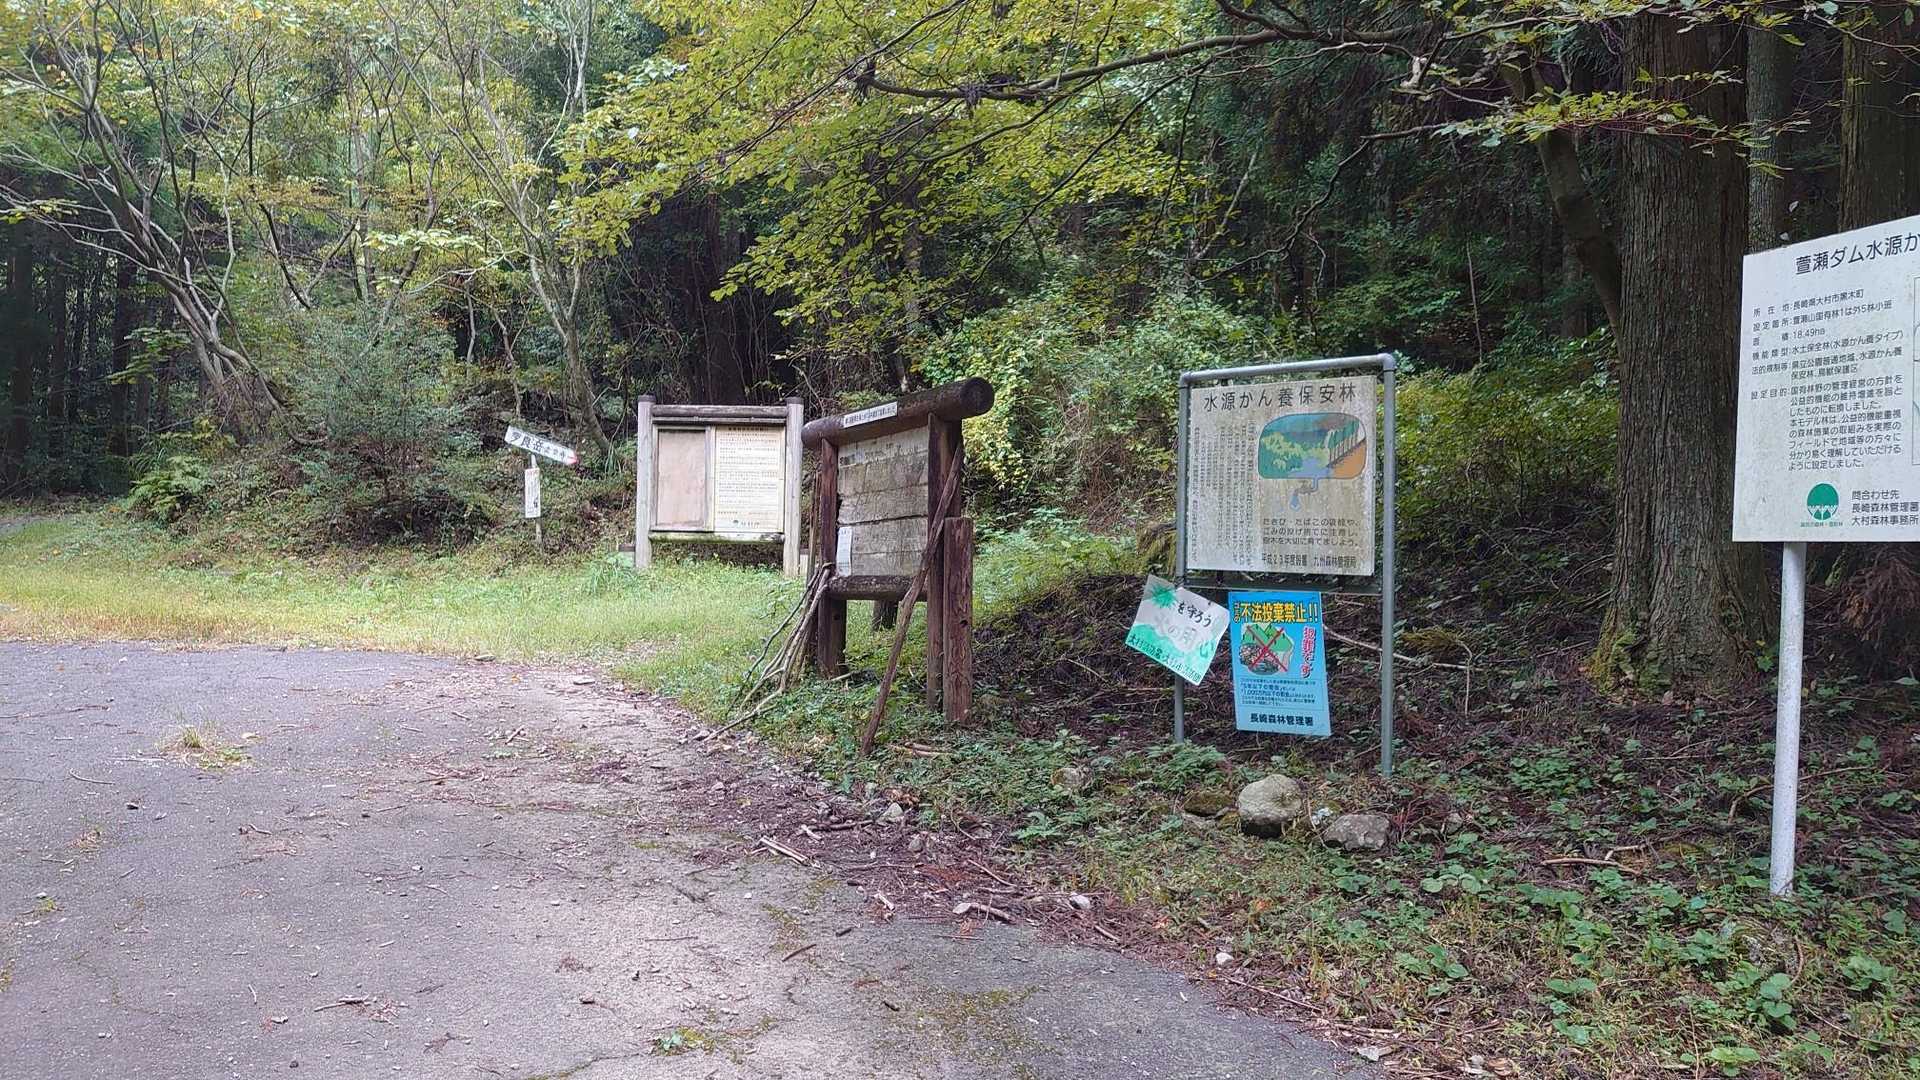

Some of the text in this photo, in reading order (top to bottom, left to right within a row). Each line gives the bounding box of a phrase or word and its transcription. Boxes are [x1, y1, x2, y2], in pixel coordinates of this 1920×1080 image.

[1204, 383, 1356, 412] 水源かん養保安林
